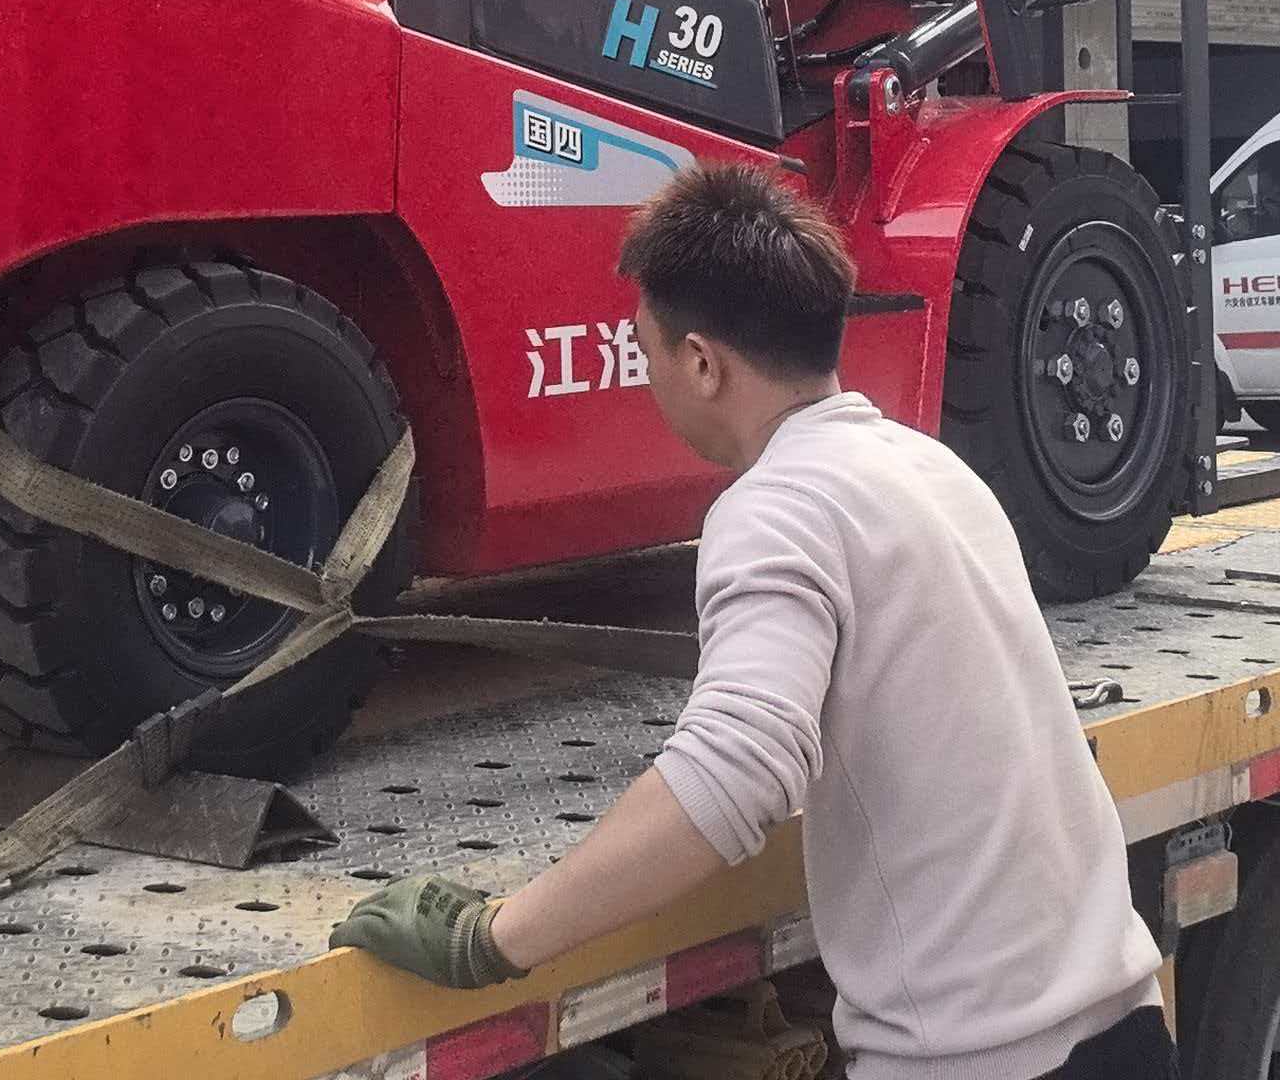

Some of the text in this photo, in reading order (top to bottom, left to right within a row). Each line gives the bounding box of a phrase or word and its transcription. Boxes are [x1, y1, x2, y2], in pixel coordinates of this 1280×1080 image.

[667, 5, 723, 58] 30
[656, 48, 715, 81] SERIES
[523, 108, 583, 163] 国四
